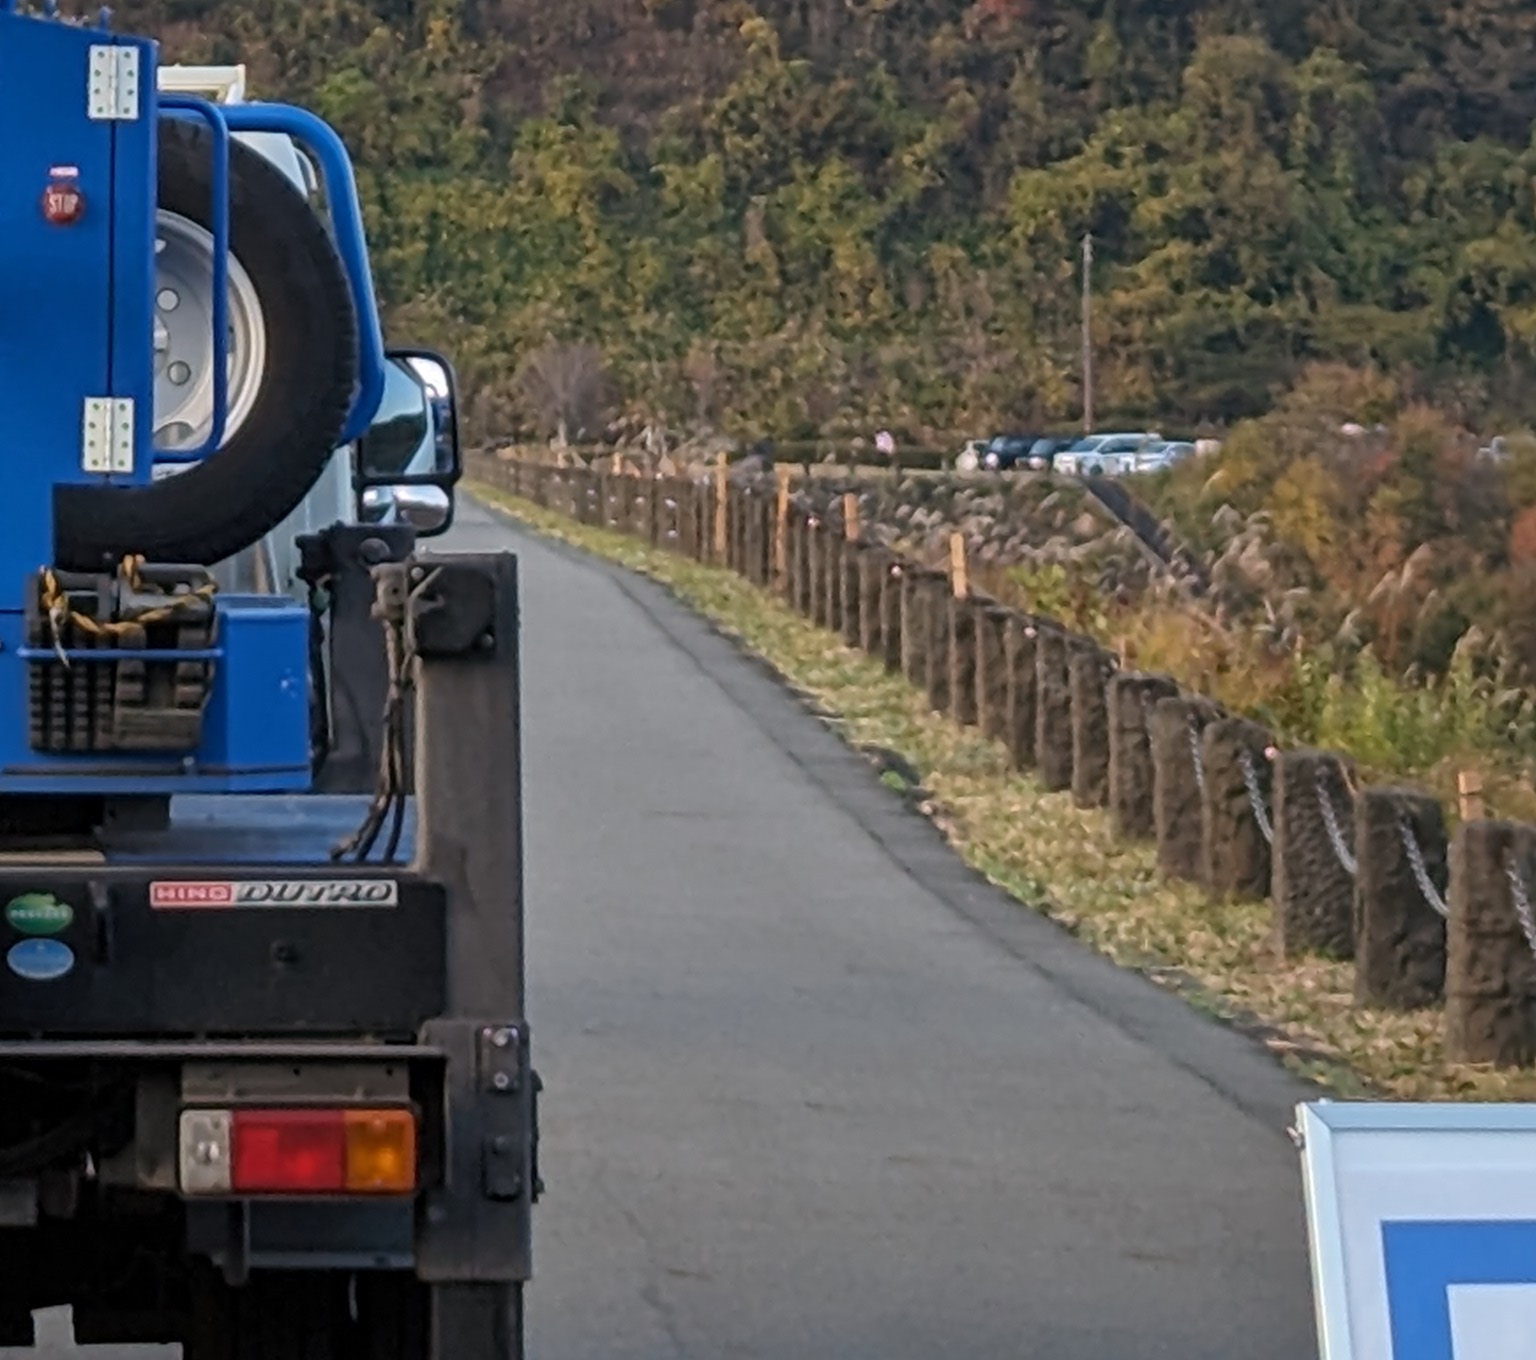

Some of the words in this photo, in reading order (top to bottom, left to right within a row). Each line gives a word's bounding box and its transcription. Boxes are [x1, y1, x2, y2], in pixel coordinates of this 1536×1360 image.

[49, 193, 79, 214] STOP
[156, 886, 229, 901] HINO
[238, 883, 393, 902] DUTRO
